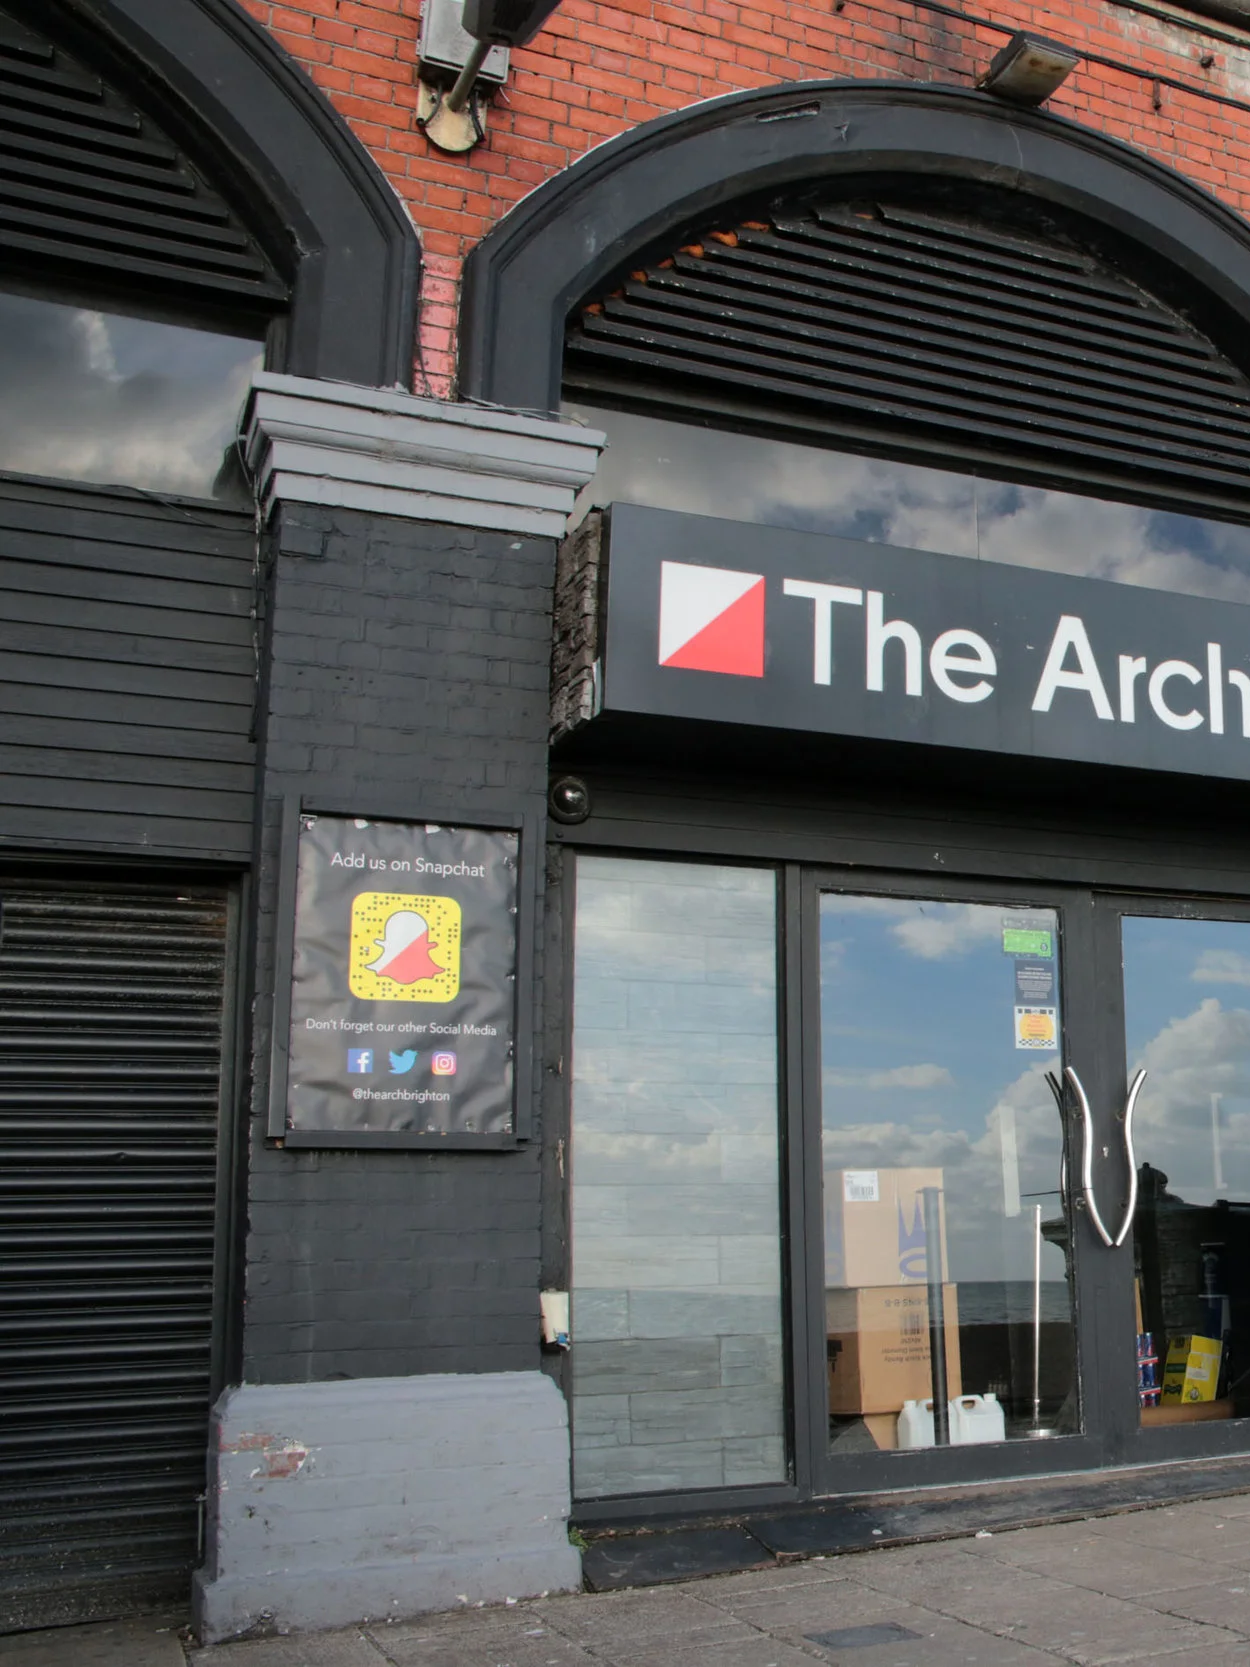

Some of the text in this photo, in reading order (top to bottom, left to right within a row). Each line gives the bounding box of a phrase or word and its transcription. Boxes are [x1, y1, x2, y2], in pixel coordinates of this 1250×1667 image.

[783, 578, 998, 704] The
[331, 852, 485, 878] Add us on Snapchat
[305, 1018, 497, 1036] Don't forget our other Social Media
[352, 1087, 450, 1104] @thearchbrighton
